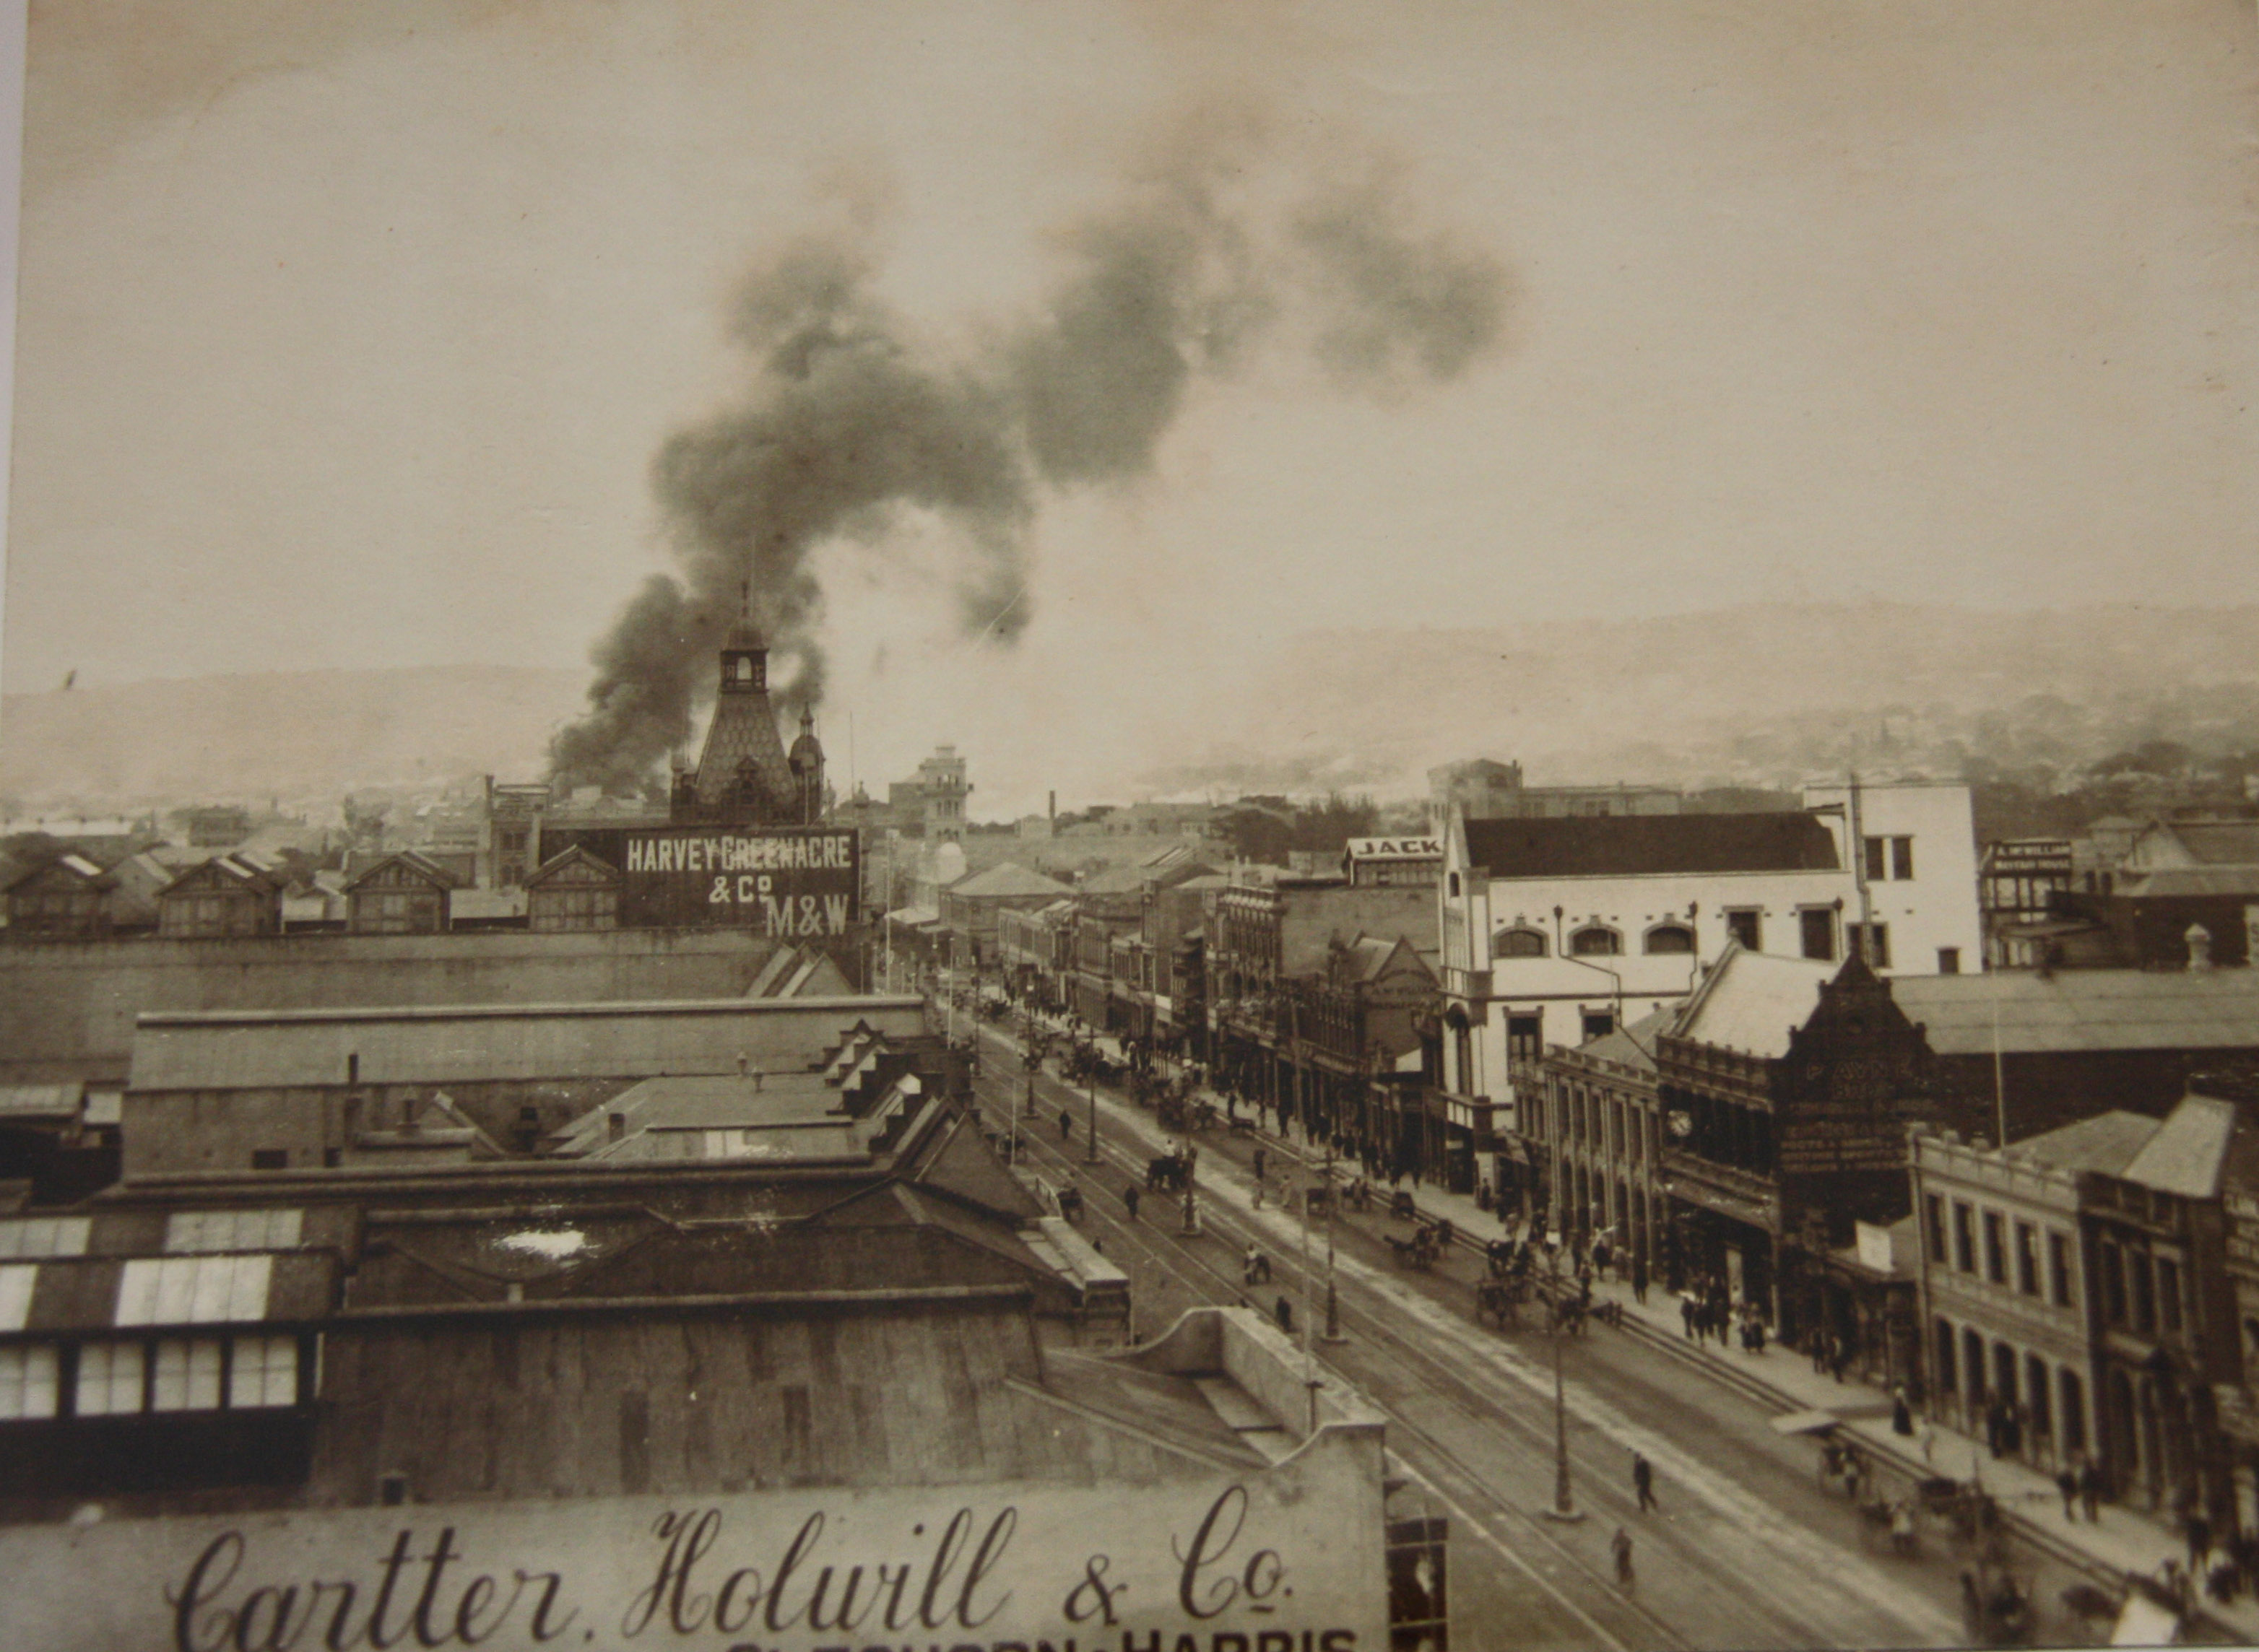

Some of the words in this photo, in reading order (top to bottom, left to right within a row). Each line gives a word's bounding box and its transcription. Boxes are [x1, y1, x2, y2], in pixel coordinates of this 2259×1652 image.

[628, 838, 719, 871] HARVEY
[721, 835, 851, 870] GREENACRE
[1358, 840, 1440, 854] JACK
[709, 876, 731, 903] &
[1062, 1554, 1128, 1626] &
